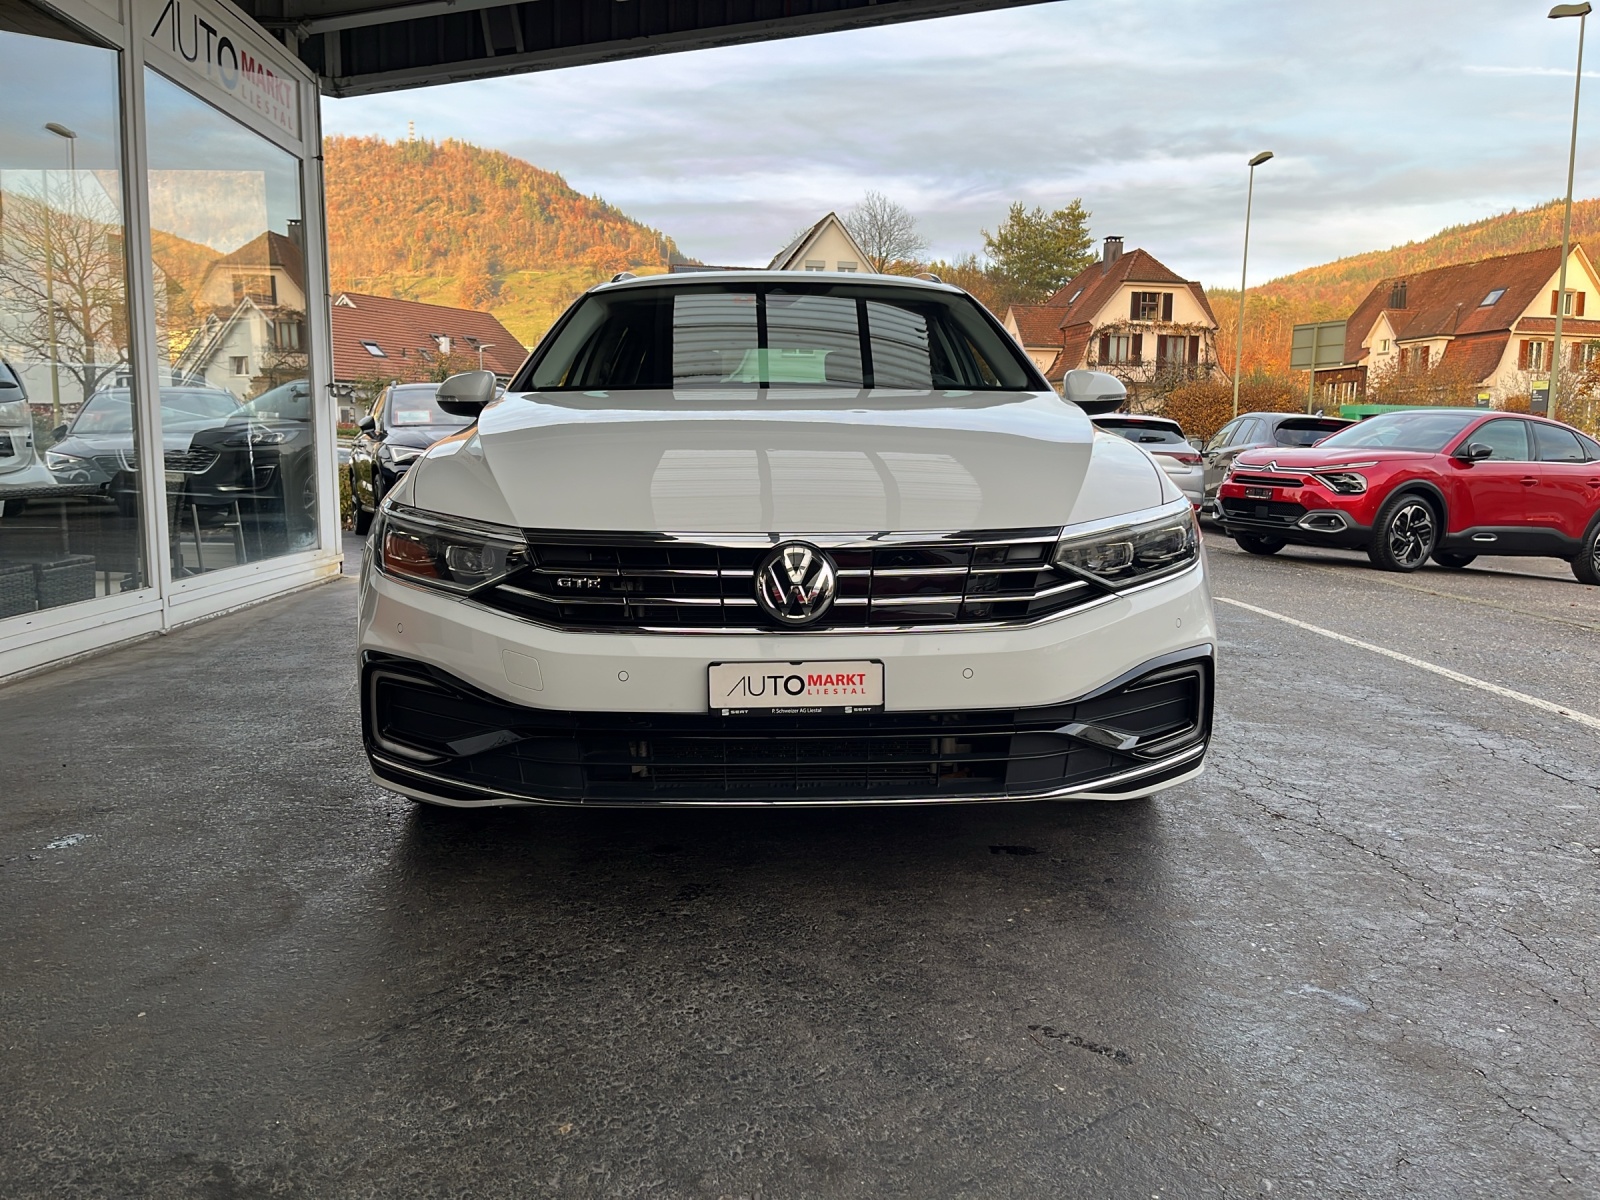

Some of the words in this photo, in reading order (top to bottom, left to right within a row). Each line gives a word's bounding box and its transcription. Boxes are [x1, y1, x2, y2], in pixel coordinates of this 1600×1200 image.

[151, 0, 238, 90] AUTO
[241, 50, 291, 109] MARKT
[241, 85, 293, 130] LIESTAL
[727, 675, 805, 696] AUTO
[807, 673, 866, 687] MARKT
